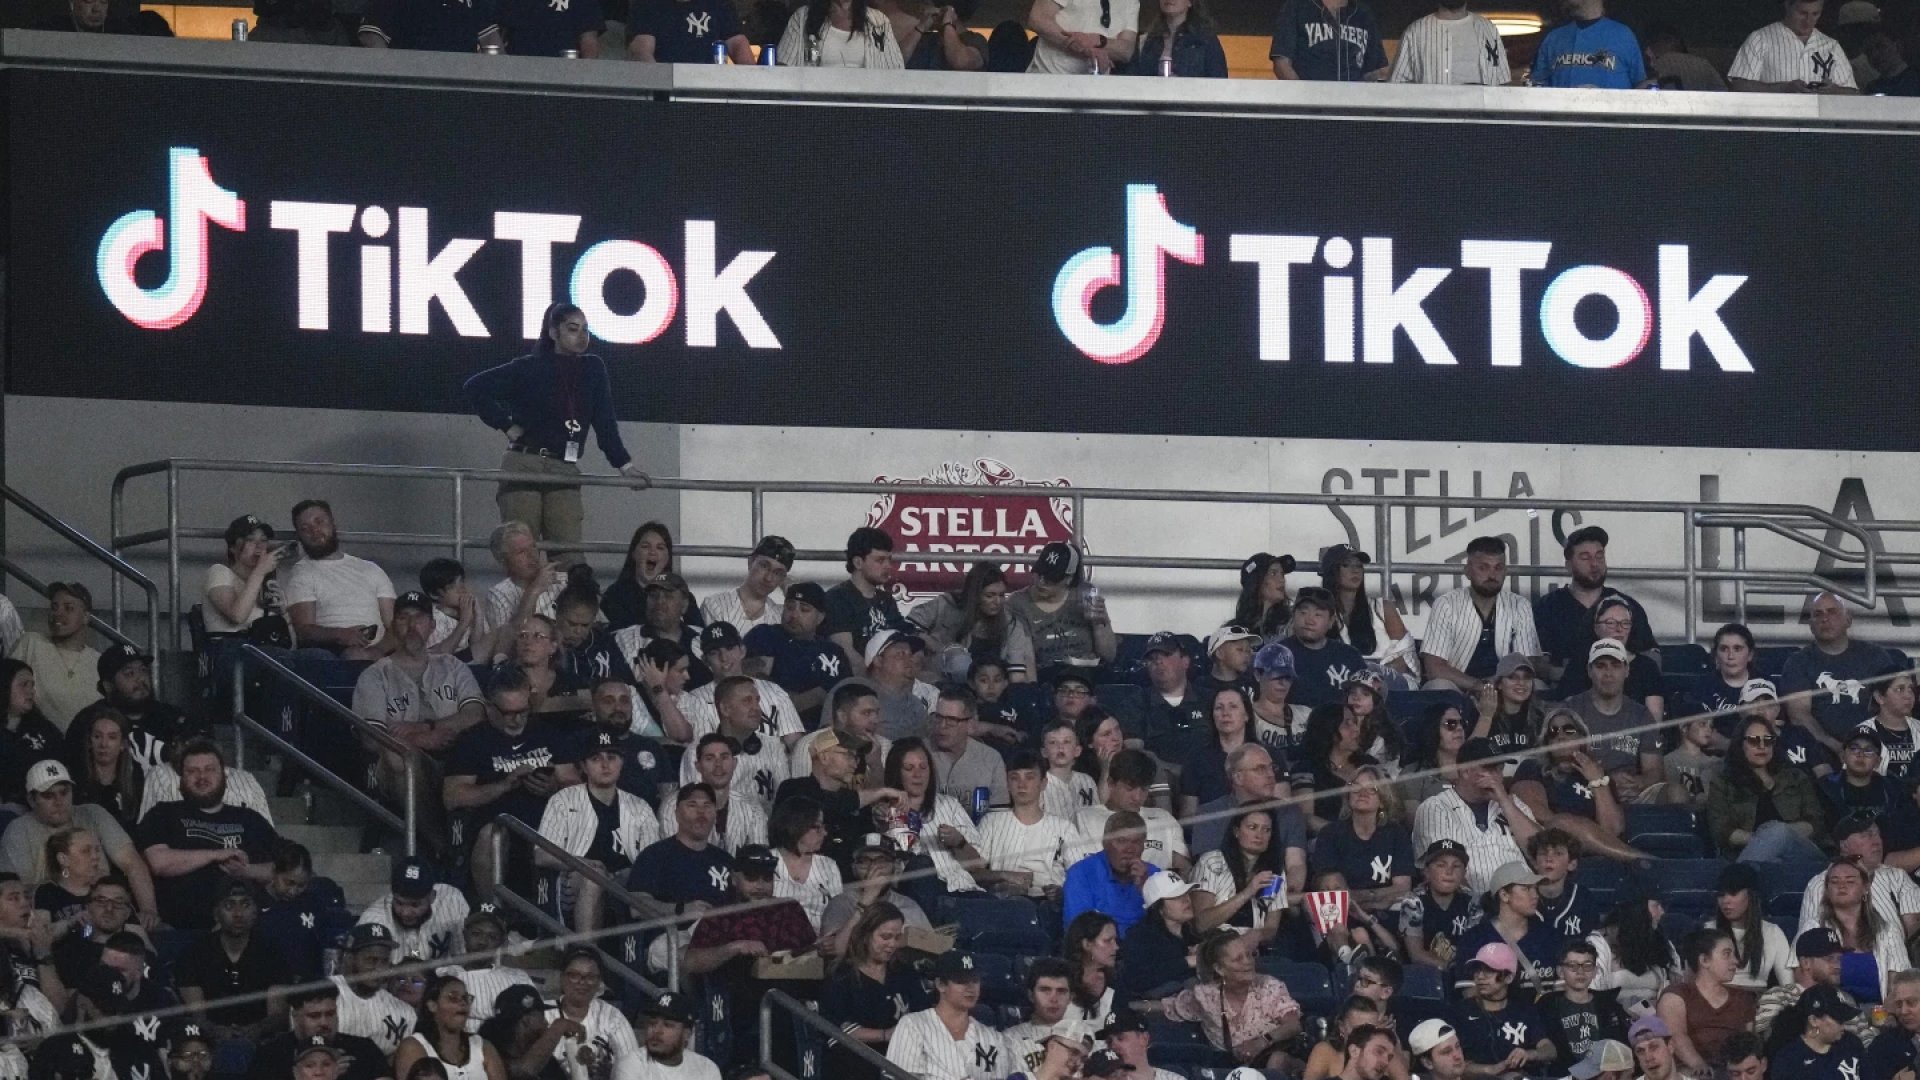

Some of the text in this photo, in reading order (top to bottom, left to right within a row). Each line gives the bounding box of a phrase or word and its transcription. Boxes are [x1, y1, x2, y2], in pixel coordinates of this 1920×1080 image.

[269, 200, 783, 351] TikTok
[1229, 233, 1757, 373] TikTok
[897, 544, 1047, 574] ARTOI
[899, 507, 1049, 538] STELLA
[1320, 467, 1535, 575] STELLA
